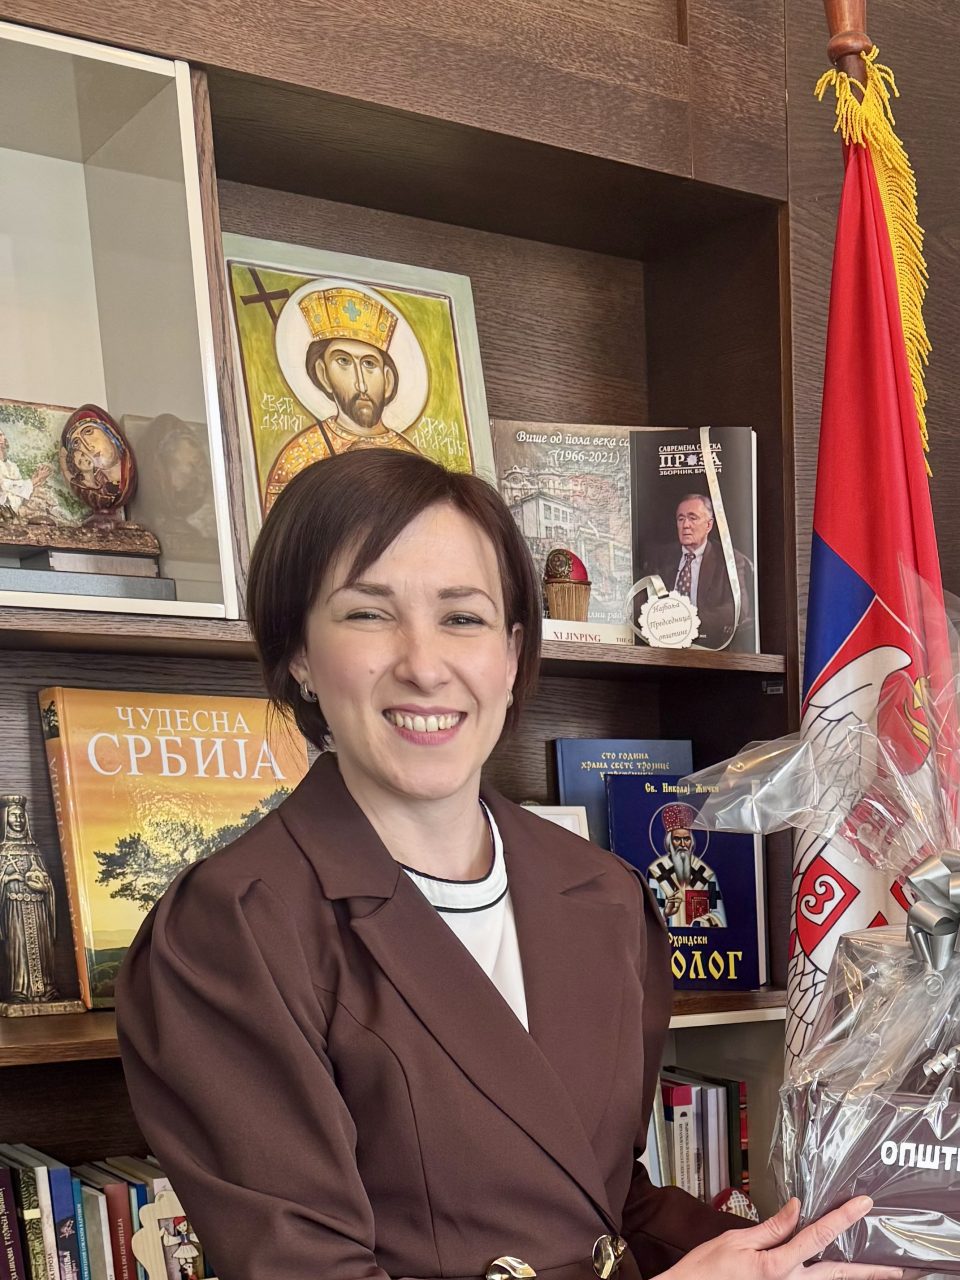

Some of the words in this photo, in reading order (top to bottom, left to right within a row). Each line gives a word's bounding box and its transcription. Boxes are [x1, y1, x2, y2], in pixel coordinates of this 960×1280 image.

[516, 430, 548, 444] Више
[549, 431, 562, 445] од
[592, 434, 616, 448] века
[658, 444, 696, 453] САВРЕМЕНА
[696, 443, 722, 451] ССКА
[553, 448, 620, 465] (1966-2021)
[653, 602, 680, 613] Најбоља
[553, 631, 563, 640] XI
[565, 632, 601, 643] JINPING
[115, 706, 251, 734] ЧУДЕСНА
[87, 732, 287, 780] СРБИЈА
[601, 752, 616, 760] СТО
[581, 761, 608, 771] ХРАМА
[611, 761, 634, 769] СВЕТЕ
[636, 761, 670, 771] ТРОЈИЦЕ
[645, 782, 658, 793] Св.
[662, 782, 690, 795] Николај
